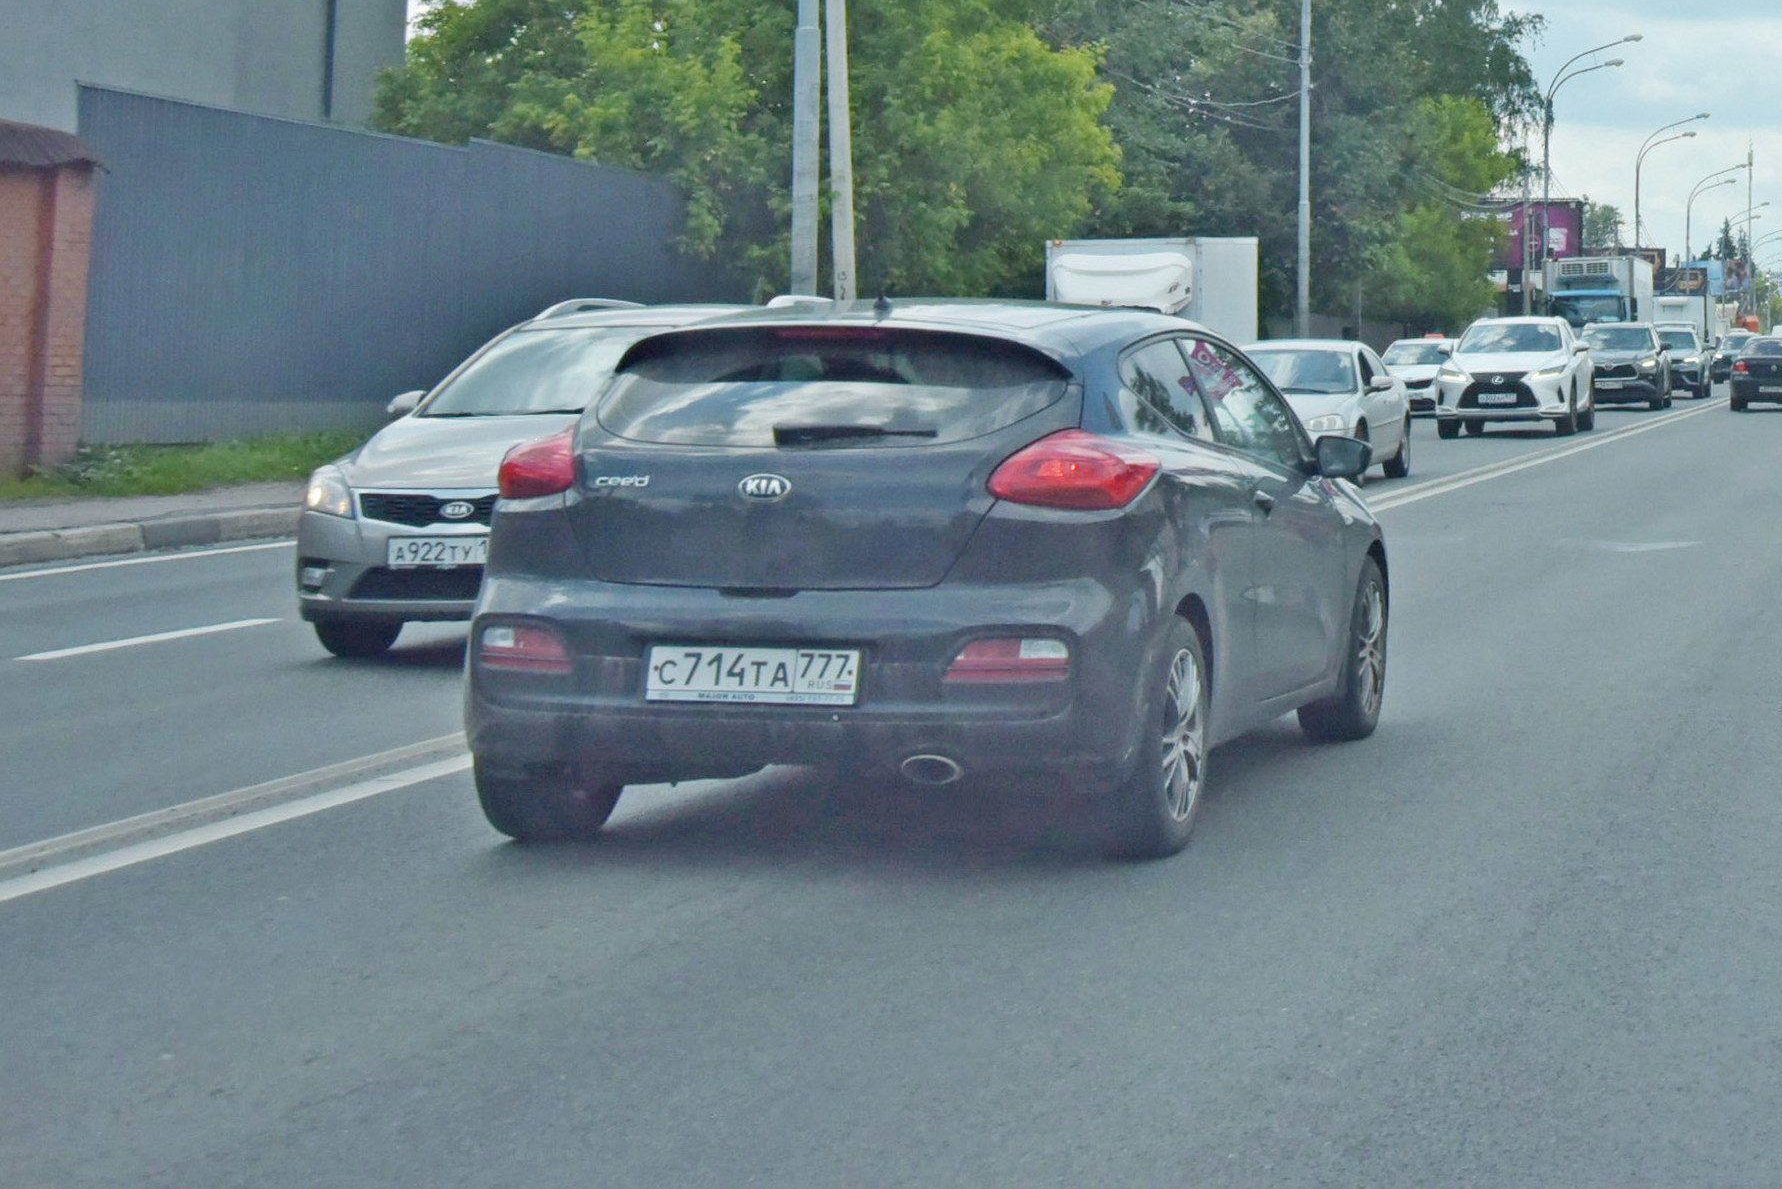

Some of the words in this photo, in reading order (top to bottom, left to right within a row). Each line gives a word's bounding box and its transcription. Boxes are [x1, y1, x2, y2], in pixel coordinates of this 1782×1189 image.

[595, 474, 650, 487] cee'd
[745, 478, 782, 495] KIA
[395, 542, 472, 562] А922ТУ
[659, 652, 790, 688] С714ТА
[800, 652, 850, 679] 777
[807, 679, 832, 689] RUS
[698, 692, 729, 701] MAJOR
[731, 693, 755, 701] AUTO
